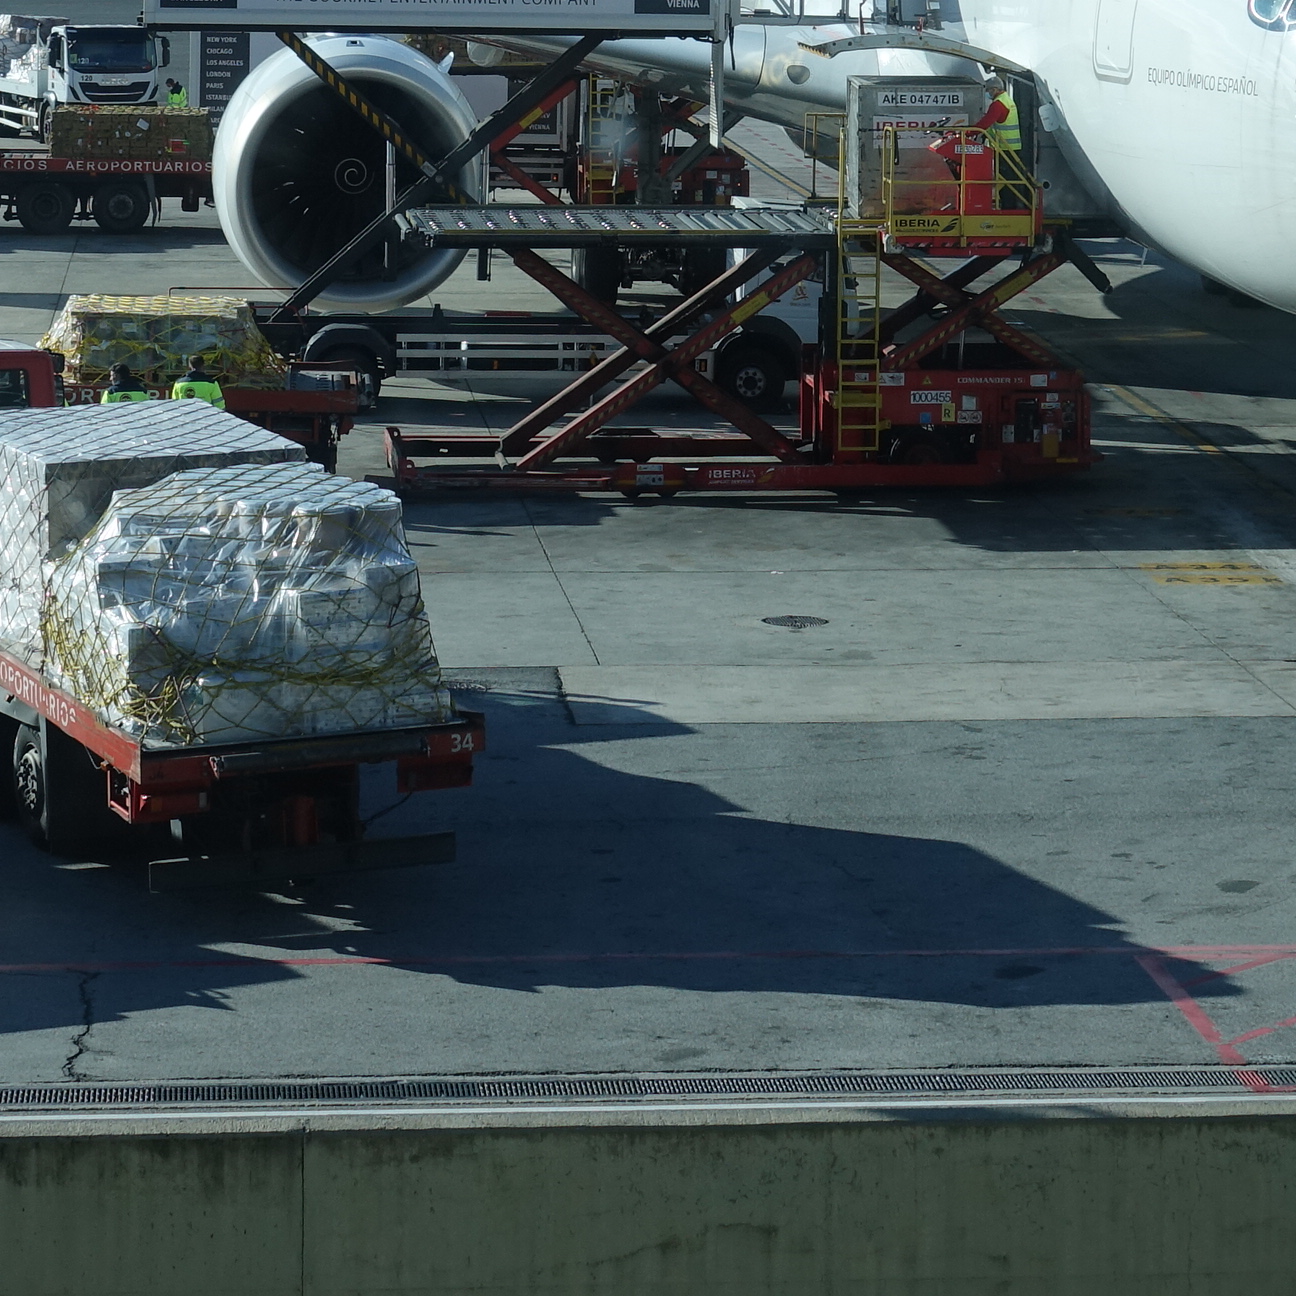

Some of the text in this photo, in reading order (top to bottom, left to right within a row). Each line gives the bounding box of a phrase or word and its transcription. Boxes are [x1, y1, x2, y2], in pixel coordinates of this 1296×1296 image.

[667, 0, 700, 8] VIENNA
[1148, 67, 1258, 97] EQUIPO OLÍMPICO ESPAÑOL
[882, 94, 907, 104] AKE
[65, 160, 212, 172] AEROPORTUARIOS
[895, 219, 940, 227] IBERIA
[912, 392, 951, 403] 1000455
[708, 469, 756, 478] IBERIA
[451, 733, 474, 753] 34
